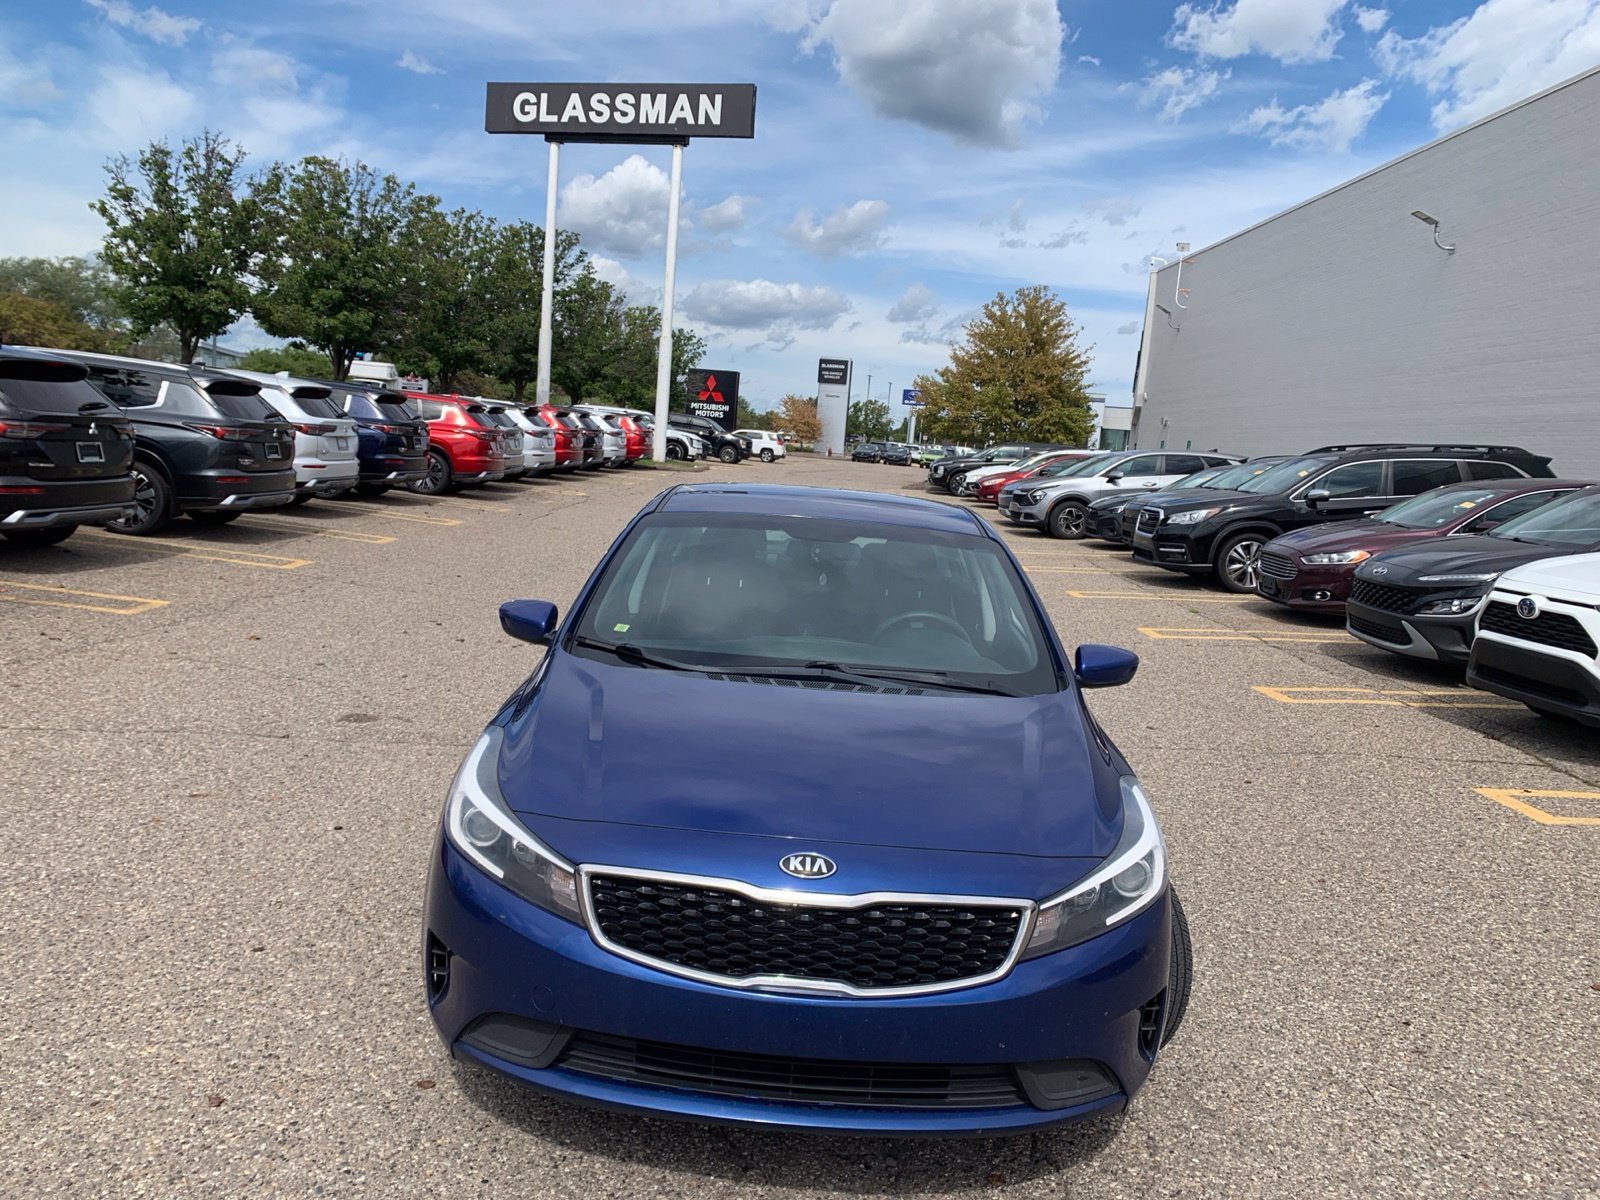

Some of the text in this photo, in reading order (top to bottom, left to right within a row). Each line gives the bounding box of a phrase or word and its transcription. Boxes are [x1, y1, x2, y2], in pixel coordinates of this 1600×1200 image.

[513, 91, 723, 125] GLASSMAN
[690, 402, 730, 411] MITSUBISHI
[695, 410, 724, 418] MOTORS
[789, 856, 828, 873] KIA
